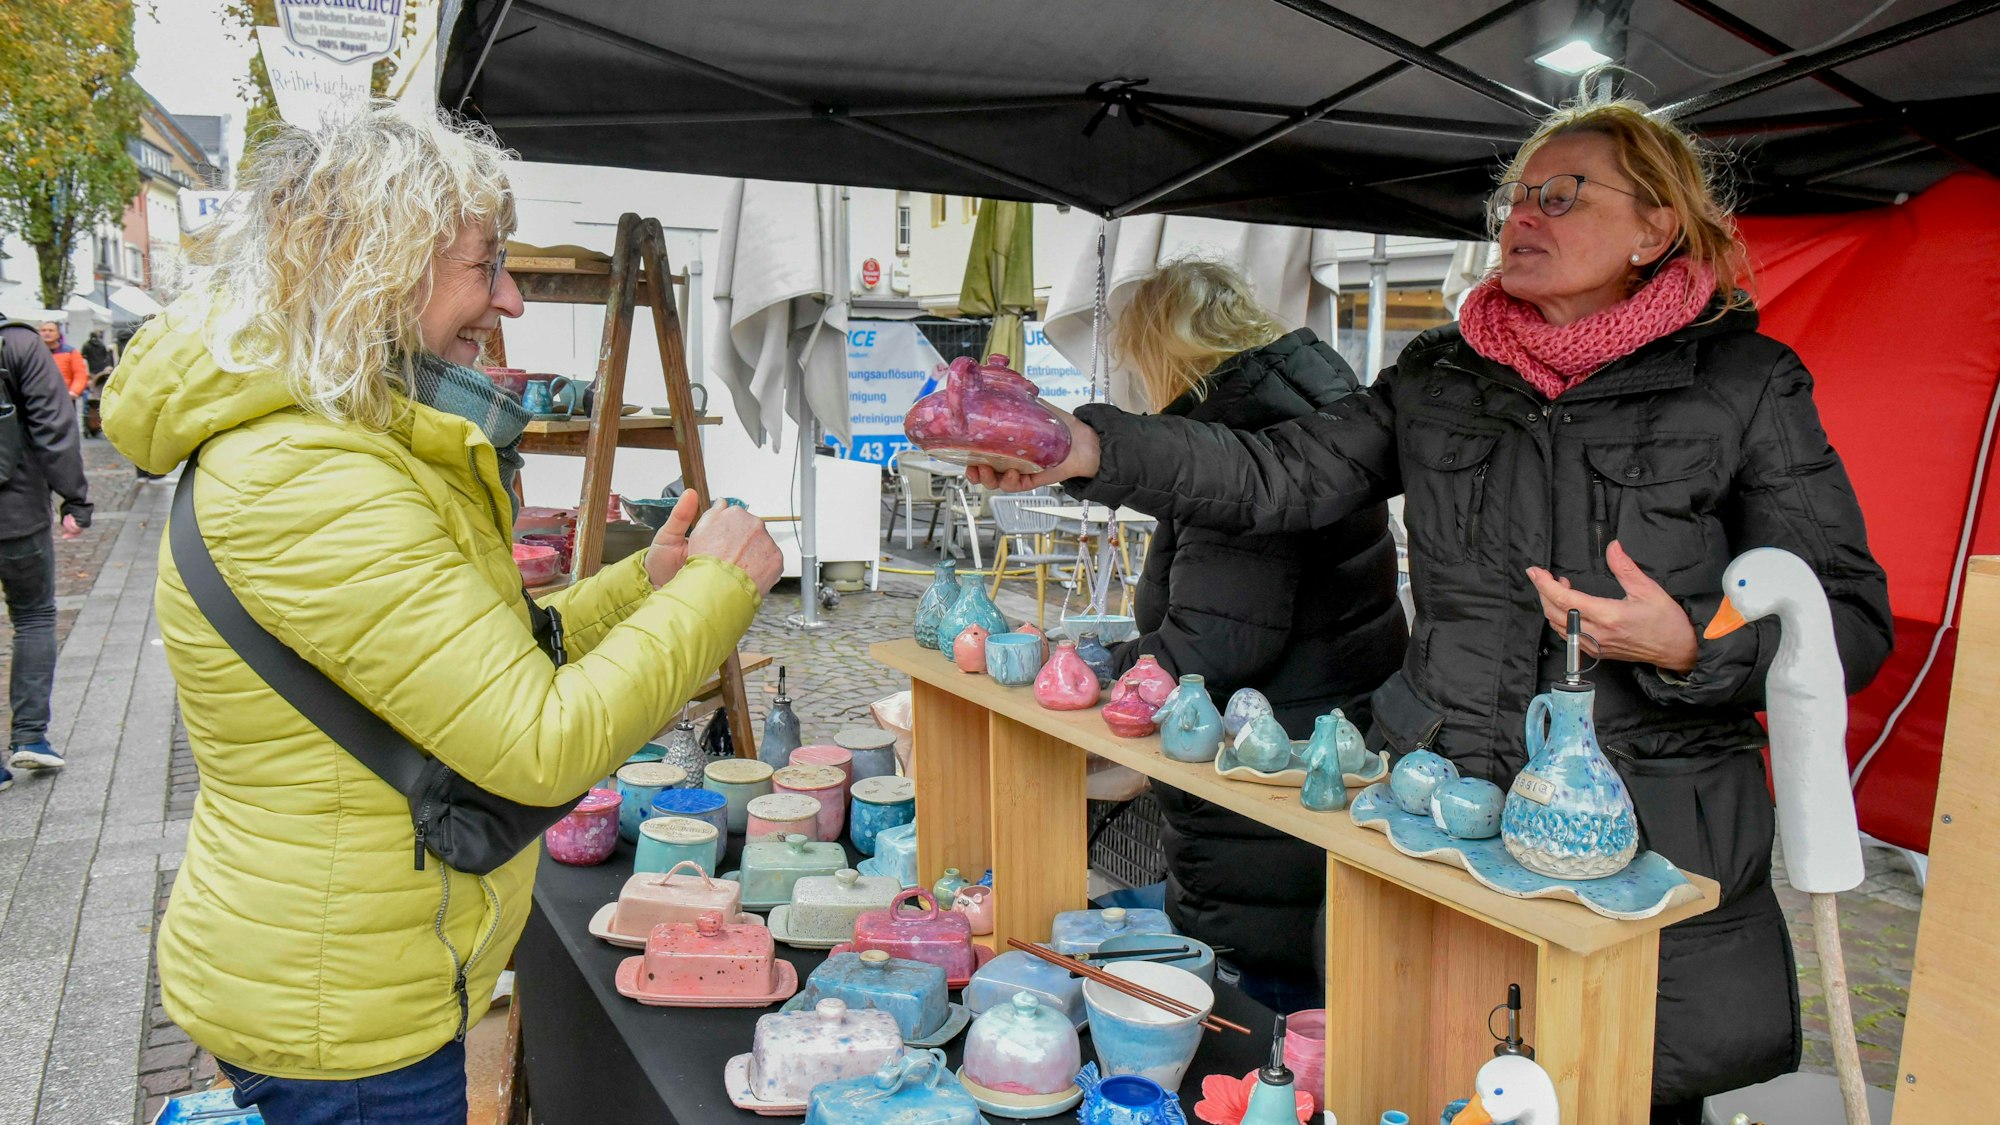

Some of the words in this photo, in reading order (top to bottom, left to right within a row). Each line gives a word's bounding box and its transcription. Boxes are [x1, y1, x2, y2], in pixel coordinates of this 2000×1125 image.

[317, 39, 338, 49] 100%
[1027, 365, 1082, 378] Entrümpelu
[850, 413, 904, 426] elreinigun
[859, 442, 884, 461] 43
